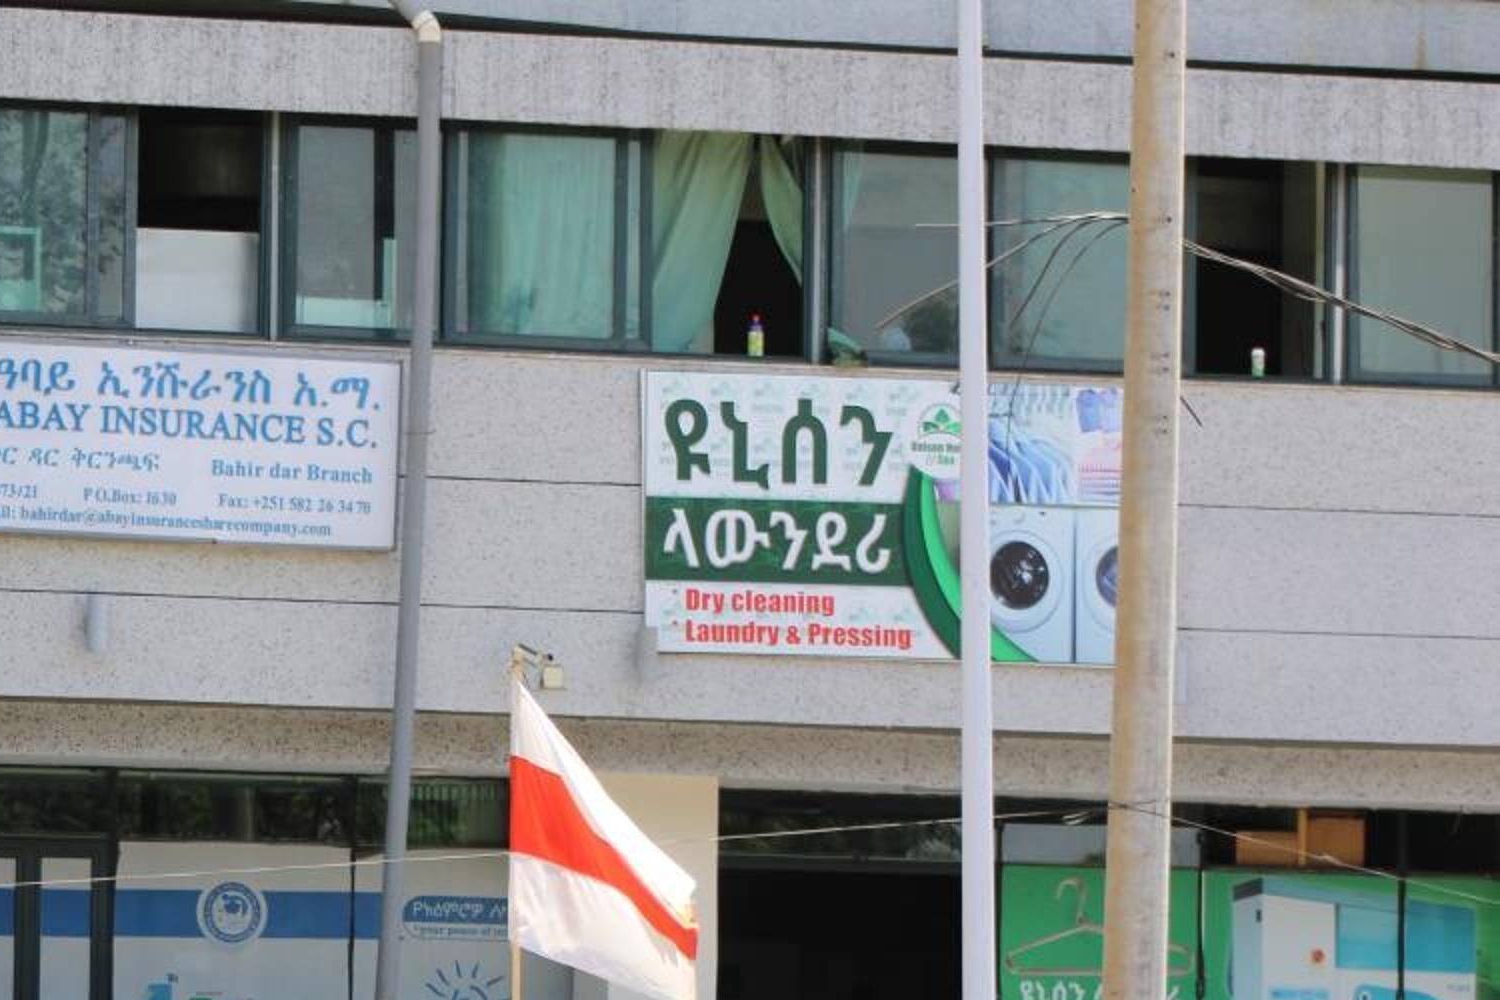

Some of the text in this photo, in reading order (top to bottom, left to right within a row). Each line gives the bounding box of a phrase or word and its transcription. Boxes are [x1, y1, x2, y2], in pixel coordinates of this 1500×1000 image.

[97, 361, 271, 405] ኢንሹራንስ
[100, 405, 306, 445] INSURANCE
[316, 416, 378, 449] S.C.
[664, 397, 894, 491] ዩኒሰን
[211, 459, 373, 484] Bahir dar Branch
[218, 493, 250, 509] Fax:
[662, 507, 891, 574] ላውንደሪ
[685, 588, 836, 617] Dry cleaning
[685, 620, 913, 650] Laundry & Pressing
